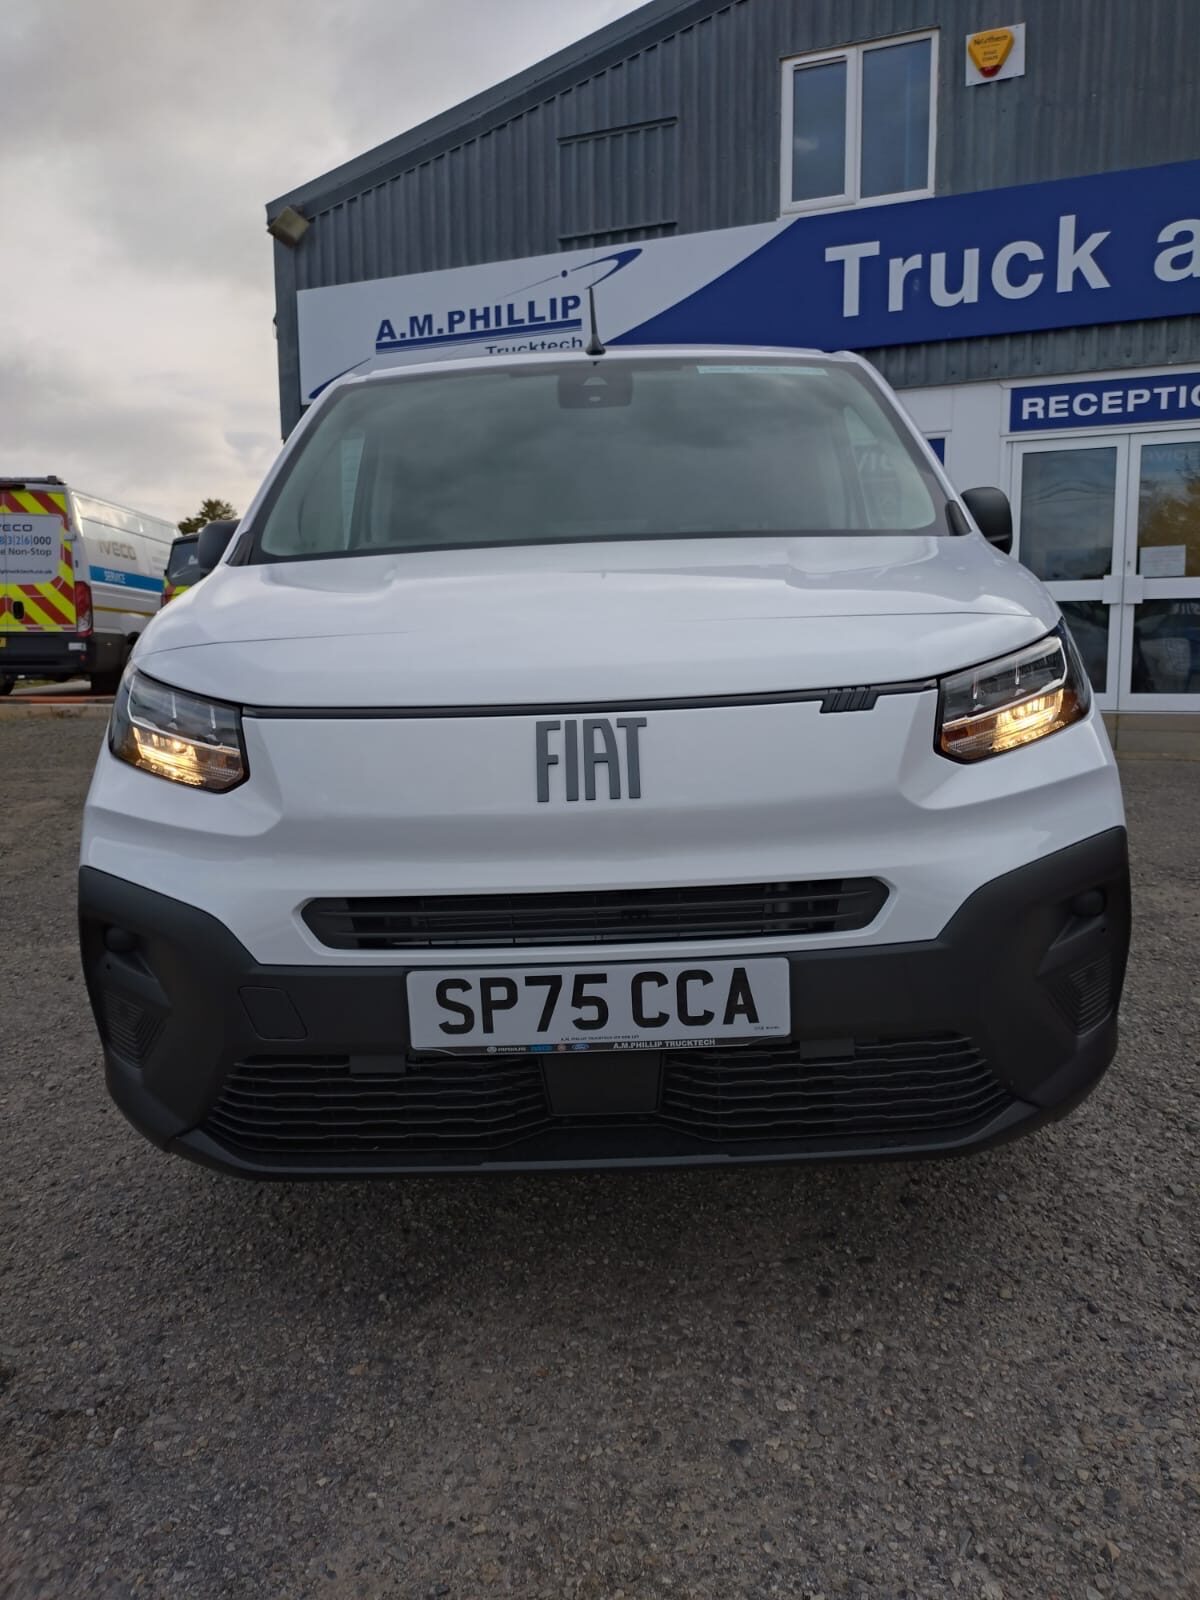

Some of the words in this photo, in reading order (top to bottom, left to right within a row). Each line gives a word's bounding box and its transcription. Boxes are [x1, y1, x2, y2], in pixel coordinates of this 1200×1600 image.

[824, 214, 1112, 317] Truck
[375, 294, 581, 342] A.M.PHILLIP
[485, 337, 583, 354] Trucktech
[0, 523, 33, 532] ECO
[8, 547, 52, 557] Non-Stop
[535, 717, 647, 803] FIAT
[434, 973, 609, 1035] SP75
[630, 967, 760, 1028] CCA
[664, 1039, 716, 1048] TRUCKTECH
